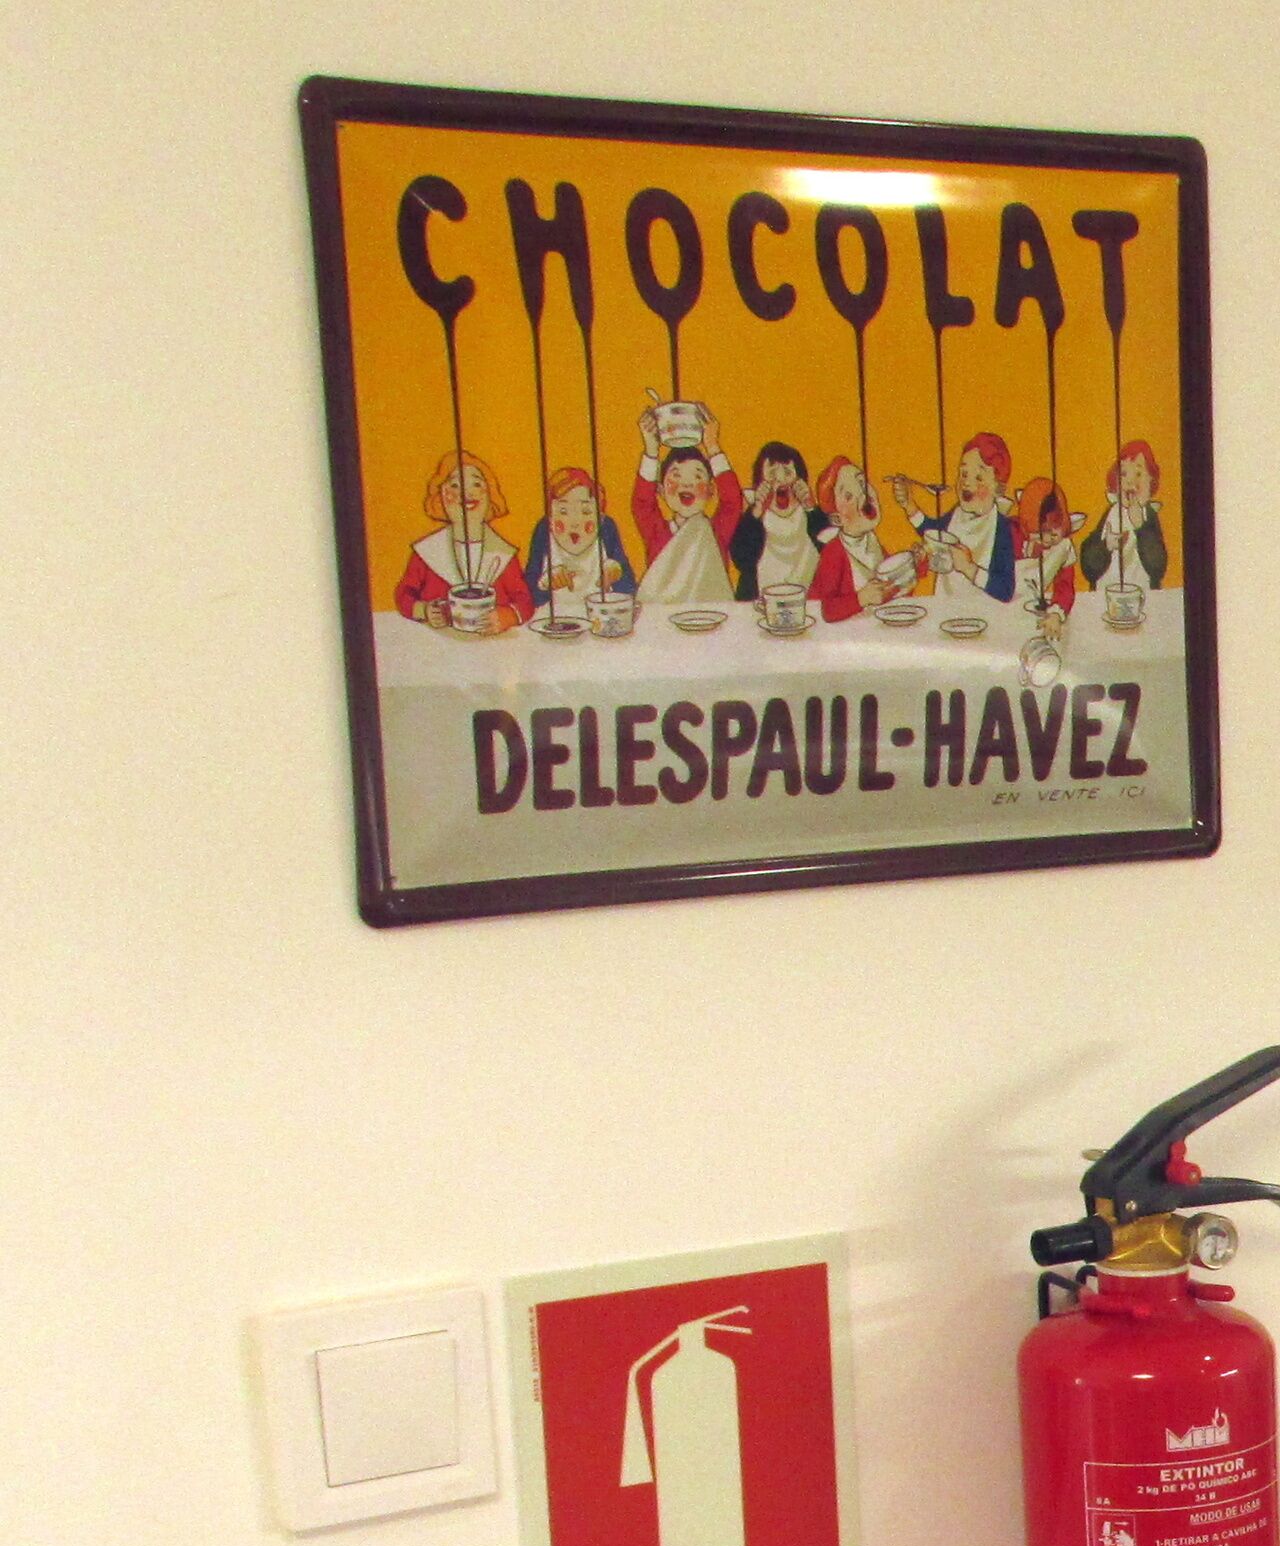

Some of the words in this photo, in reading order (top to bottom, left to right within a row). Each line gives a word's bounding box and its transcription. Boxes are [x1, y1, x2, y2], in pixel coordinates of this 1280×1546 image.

[397, 173, 1139, 328] CHOCOLAT
[473, 682, 1149, 815] DELESPAUL-HAVEZ
[991, 791, 1021, 805] EN
[1037, 786, 1101, 801] VENTE
[1119, 785, 1147, 799] ICI
[1159, 1457, 1245, 1482] EXTINTOR
[1136, 1485, 1145, 1495] 2
[1189, 1509, 1223, 1523] MODO
[1224, 1505, 1239, 1518] DE
[1211, 1532, 1220, 1542] A
